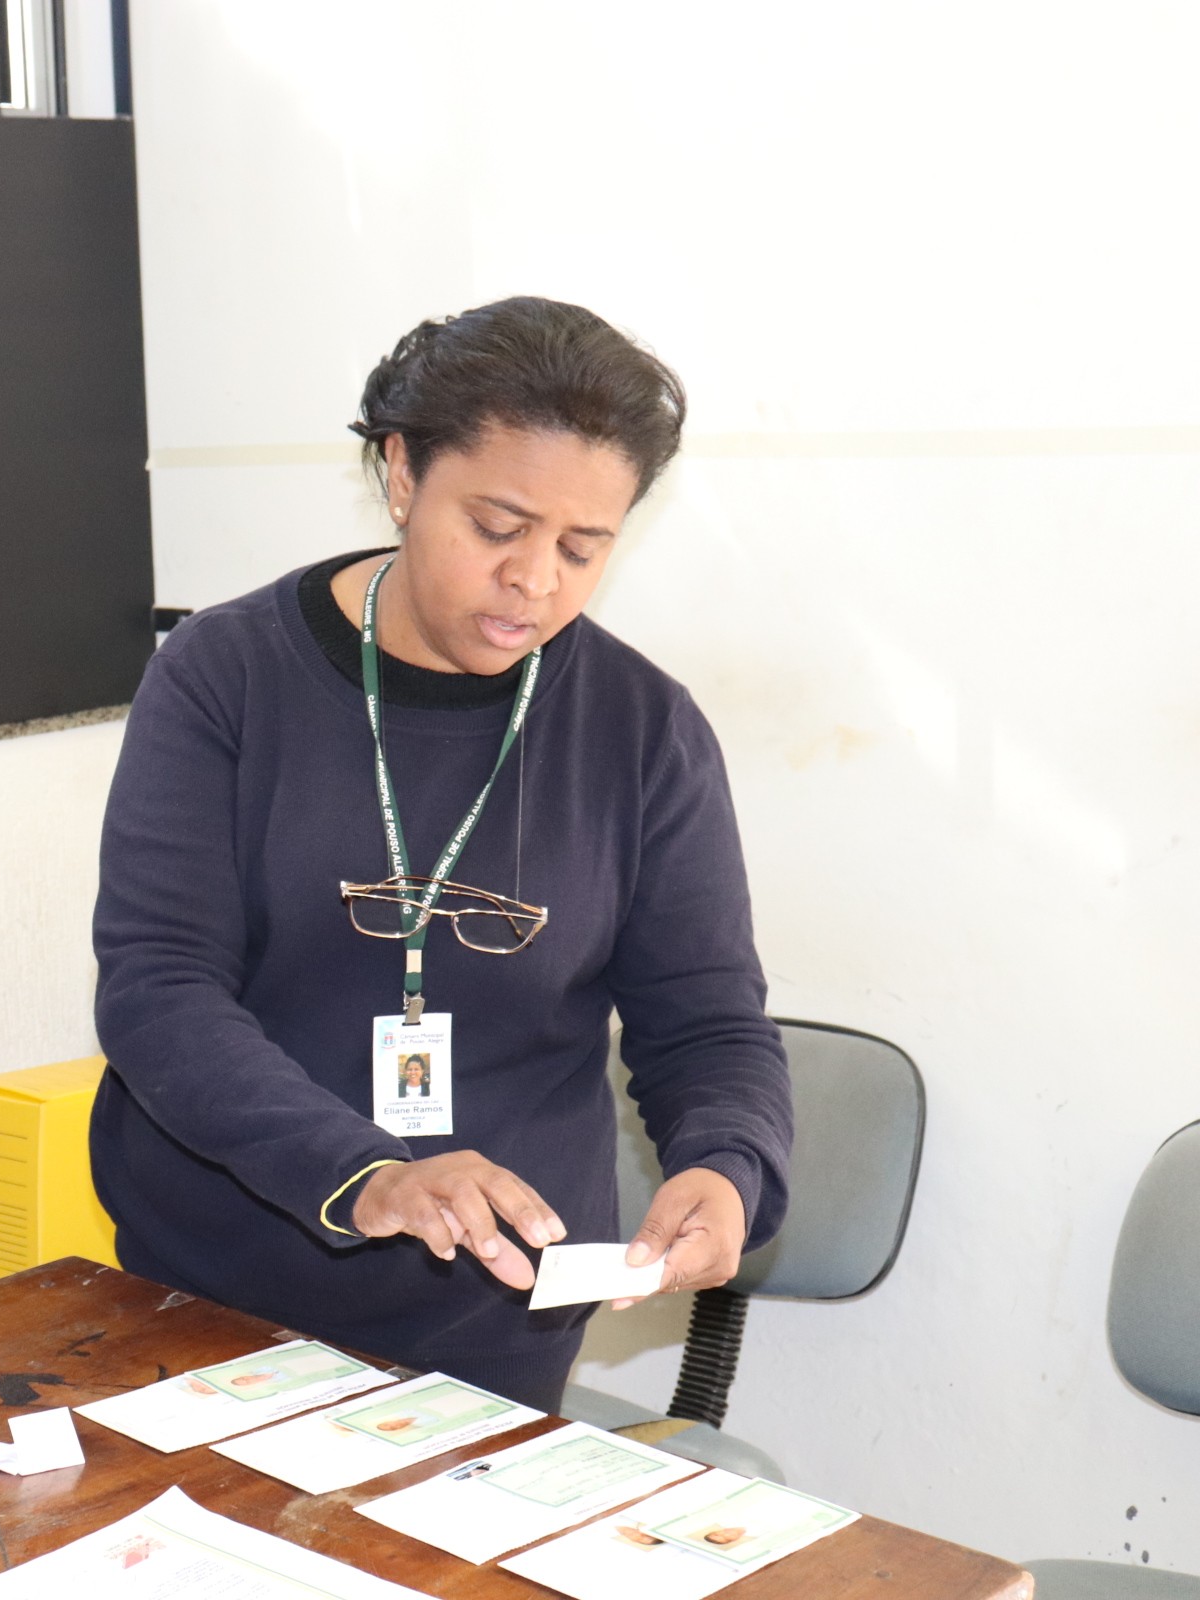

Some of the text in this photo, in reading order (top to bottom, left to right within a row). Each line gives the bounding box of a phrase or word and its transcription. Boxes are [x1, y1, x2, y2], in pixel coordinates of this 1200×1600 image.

[363, 594, 373, 626] ALEGRE
[384, 807, 393, 822] DE
[386, 821, 400, 854] POUSO
[448, 840, 459, 856] DE
[454, 814, 475, 844] POUSO
[384, 1105, 443, 1115] Eliane Ramos
[406, 1122, 421, 1130] 238
